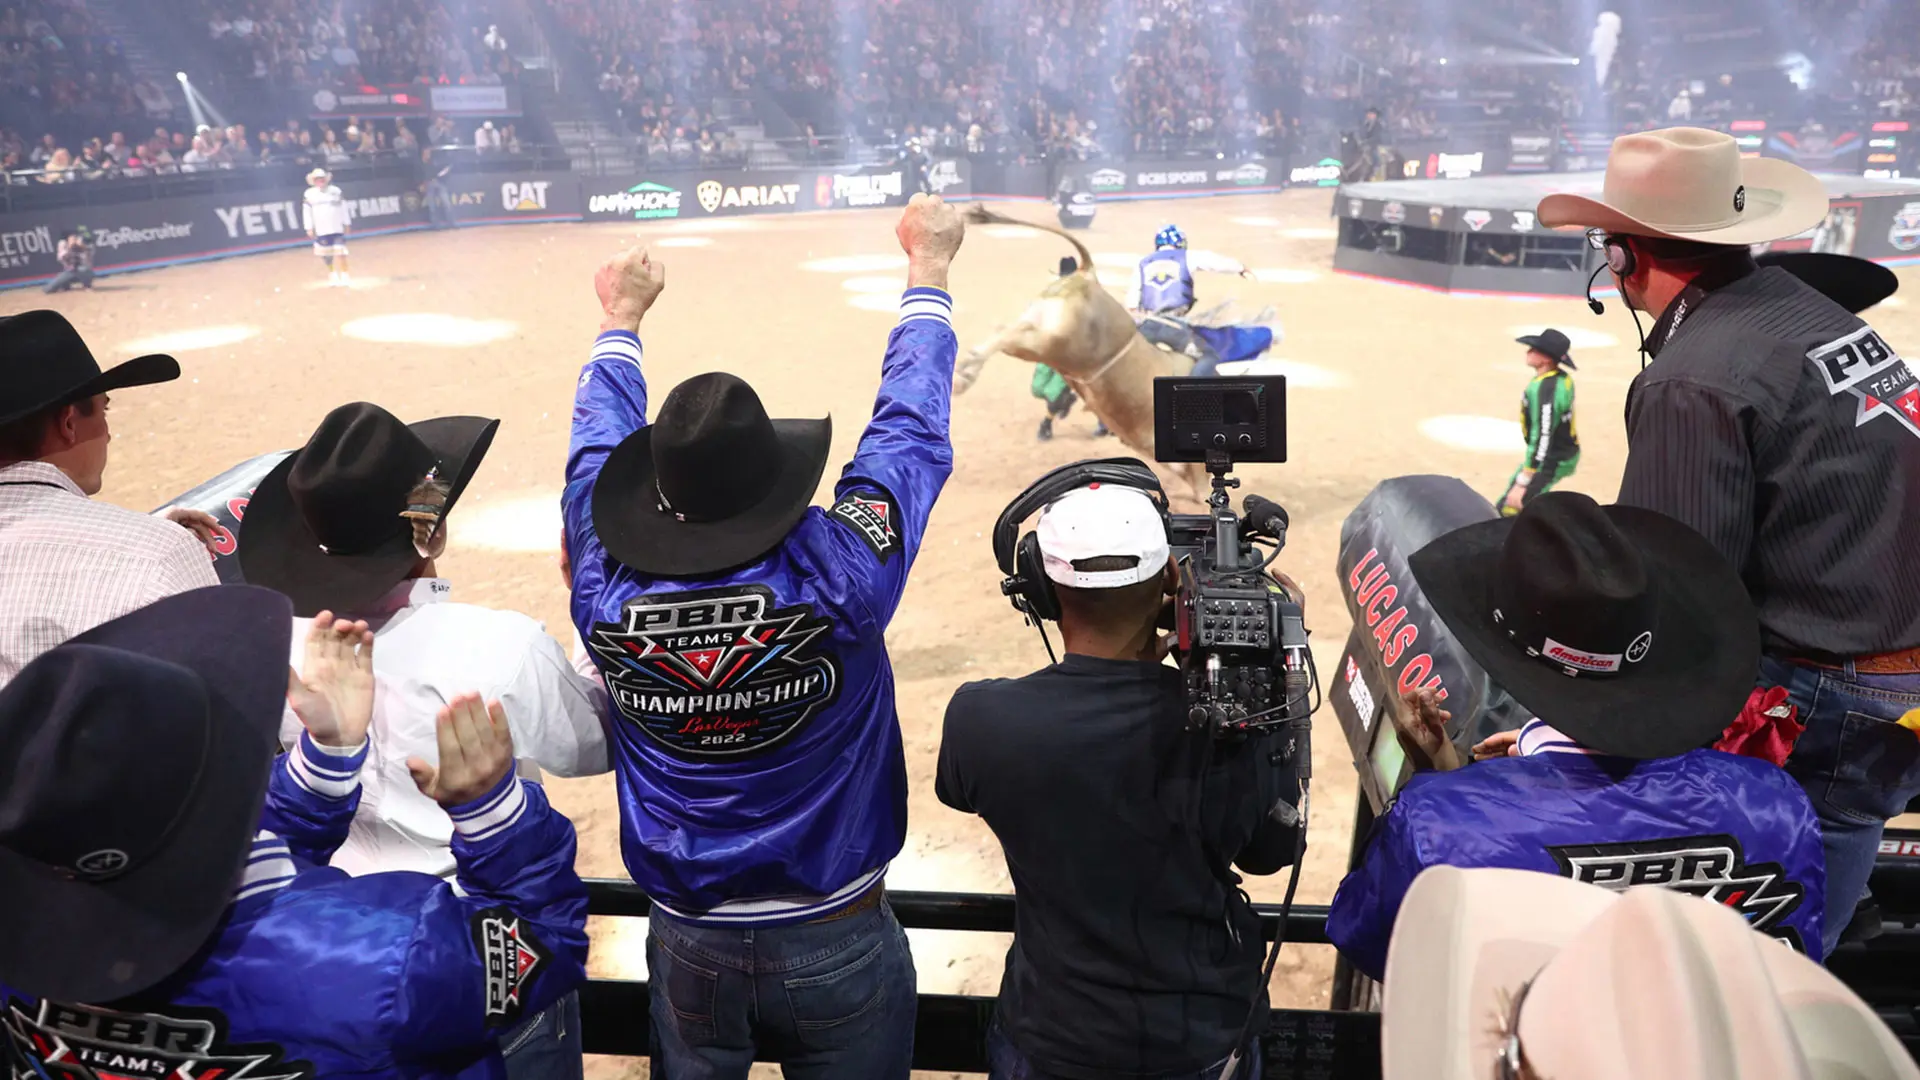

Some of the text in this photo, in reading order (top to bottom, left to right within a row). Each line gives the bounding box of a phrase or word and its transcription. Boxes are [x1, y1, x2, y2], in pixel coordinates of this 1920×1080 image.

[502, 181, 549, 211] CAT
[722, 184, 800, 207] ARIAT
[93, 223, 191, 249] ZipRecruiter
[214, 201, 299, 238] YETI
[0, 226, 54, 256] ETON
[836, 503, 890, 550] PBR
[630, 596, 766, 633] PBR
[1349, 548, 1418, 668] LUCAS
[664, 632, 733, 649] TEAMS
[1549, 646, 1614, 667] American
[619, 673, 819, 714] CHAMPIONSHIP
[700, 733, 747, 745] 2022
[1572, 848, 1732, 888] PBR
[483, 918, 506, 1016] PBR
[506, 940, 516, 988] TEAMS
[79, 1046, 166, 1073] TEAMS
